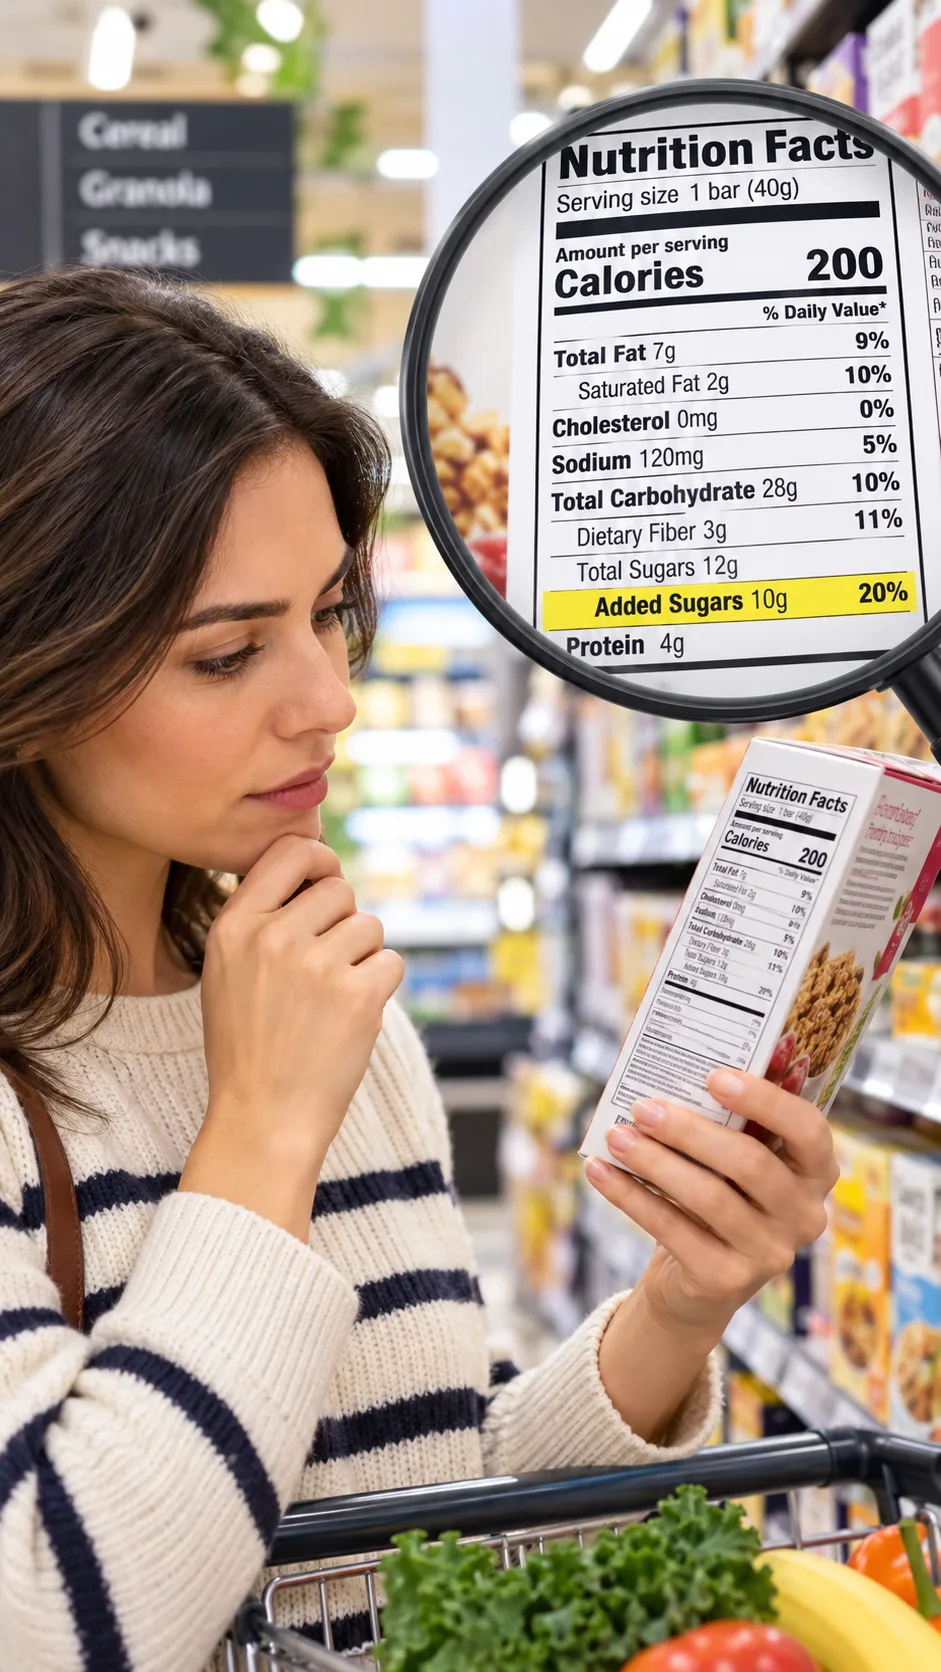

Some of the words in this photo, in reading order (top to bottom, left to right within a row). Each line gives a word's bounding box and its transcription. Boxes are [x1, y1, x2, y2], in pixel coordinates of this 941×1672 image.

[78, 111, 188, 150] Cereal
[558, 134, 753, 180] Nutrition
[765, 127, 875, 164] Facts
[79, 169, 212, 208] Granola
[556, 189, 633, 214] Serving
[640, 186, 680, 205] size
[690, 183, 700, 203] 1
[708, 181, 740, 201] bar
[747, 177, 800, 202] (40g)
[80, 228, 202, 268] Snacks
[555, 242, 626, 264] Amount
[631, 241, 660, 258] per
[663, 235, 729, 255] serving
[554, 260, 704, 299] Calories
[806, 246, 883, 281] 200
[762, 304, 779, 321] %
[784, 301, 827, 321] Daily
[553, 345, 607, 368] Total
[613, 342, 647, 363] Fat
[652, 342, 676, 363] 7g
[855, 331, 890, 351] 9%
[578, 376, 665, 401] Saturated
[671, 374, 701, 394] Fat
[706, 372, 730, 394] 2g
[845, 364, 892, 384] 10%
[552, 411, 670, 439] Cholesterol
[677, 408, 718, 431] 0mg
[859, 399, 894, 419] 0%
[551, 451, 632, 475] Sodium
[639, 447, 704, 470] 120mg
[862, 435, 897, 455] 5%
[551, 490, 603, 513] Total
[610, 480, 755, 508] Carbohydrate
[762, 477, 798, 501] 28g
[852, 472, 900, 493] 10%
[577, 525, 642, 550] Dietary
[649, 522, 696, 543] Fiber
[703, 520, 727, 544] 3g
[854, 508, 903, 530] 11%
[576, 560, 622, 583] Total
[629, 558, 695, 582] Sugars
[703, 555, 739, 580] 12g
[594, 594, 662, 618] Added
[669, 590, 743, 617] Sugars
[751, 588, 788, 613] 10g
[859, 581, 909, 603] 20%
[566, 634, 645, 658] Protein
[659, 632, 685, 657] 4g
[745, 777, 808, 804] Nutrition
[809, 791, 848, 814] Facts
[762, 803, 775, 814] size
[751, 824, 762, 834] per
[724, 830, 770, 853] Calories
[798, 847, 828, 868] 200
[791, 904, 806, 918] 10%
[801, 889, 812, 902] 9%
[773, 948, 789, 961] 10%
